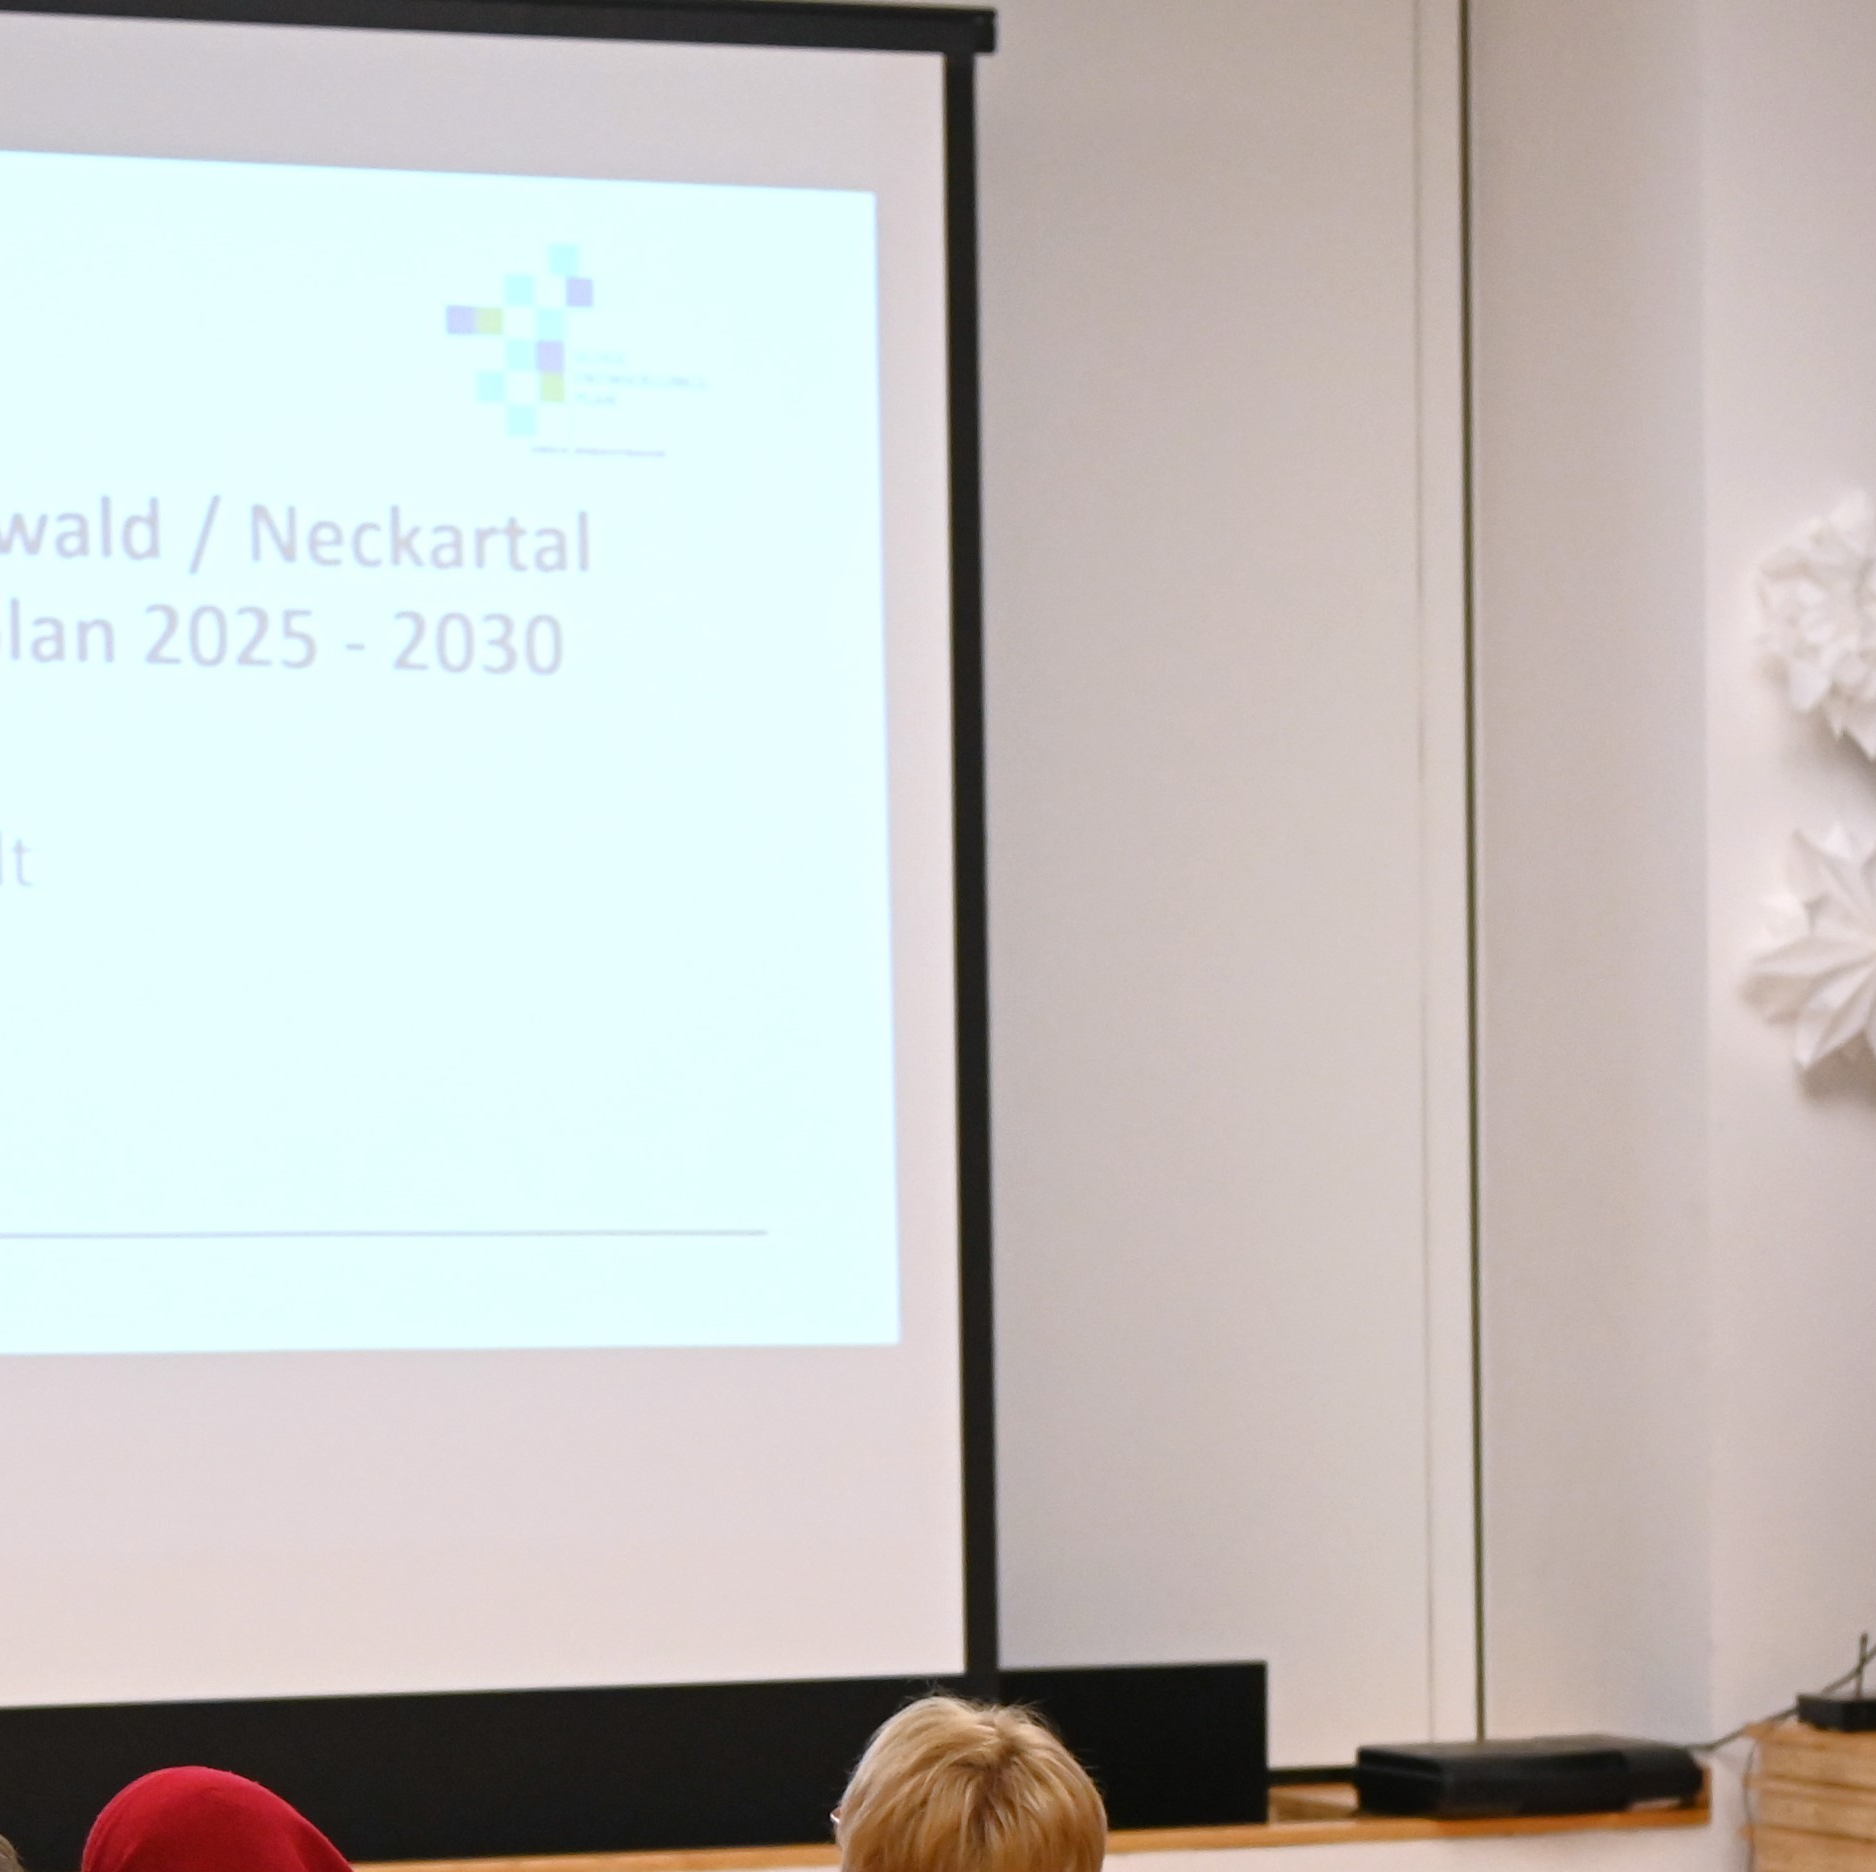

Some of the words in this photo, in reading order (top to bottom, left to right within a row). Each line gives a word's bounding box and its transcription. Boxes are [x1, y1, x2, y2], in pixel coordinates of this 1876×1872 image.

[189, 495, 222, 575] /
[251, 502, 593, 572] Neckartal
[143, 602, 319, 670] 2025
[392, 609, 564, 675] 2030
